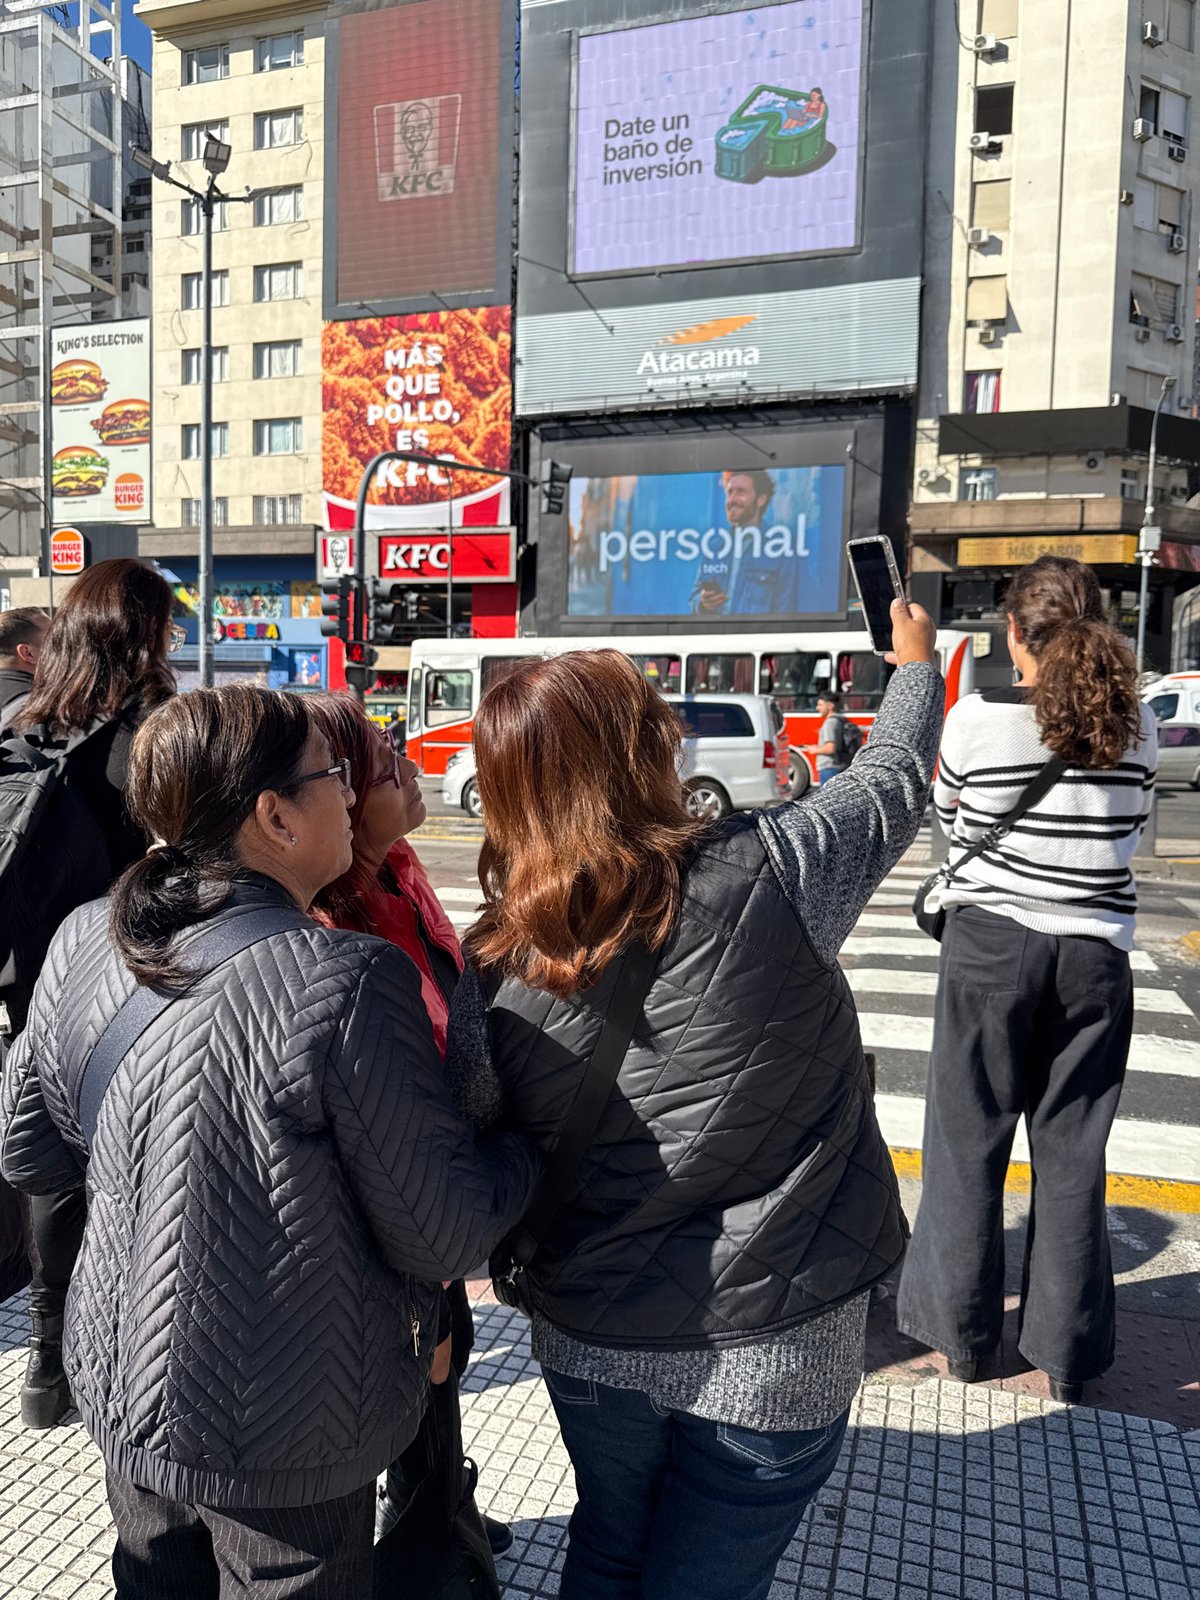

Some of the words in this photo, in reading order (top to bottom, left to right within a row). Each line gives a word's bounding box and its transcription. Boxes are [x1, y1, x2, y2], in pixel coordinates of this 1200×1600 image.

[605, 117, 656, 139] Date
[662, 114, 689, 131] un
[604, 139, 658, 162] baño
[665, 134, 693, 154] de
[603, 154, 702, 186] inversión
[389, 171, 443, 196] KFC
[57, 336, 89, 354] KING'S
[91, 333, 144, 347] SELECTION
[384, 341, 444, 369] MÁS
[636, 347, 760, 375] Atacama
[385, 373, 441, 400] QUE
[367, 399, 461, 426] POLLO,
[396, 429, 430, 451] ES
[376, 454, 455, 488] KFC
[114, 484, 144, 493] BURGER
[114, 493, 144, 504] KING
[52, 542, 82, 551] BURGER
[599, 513, 809, 572] personal
[52, 552, 82, 563] KING
[384, 543, 450, 570] KFC
[703, 563, 728, 573] tech
